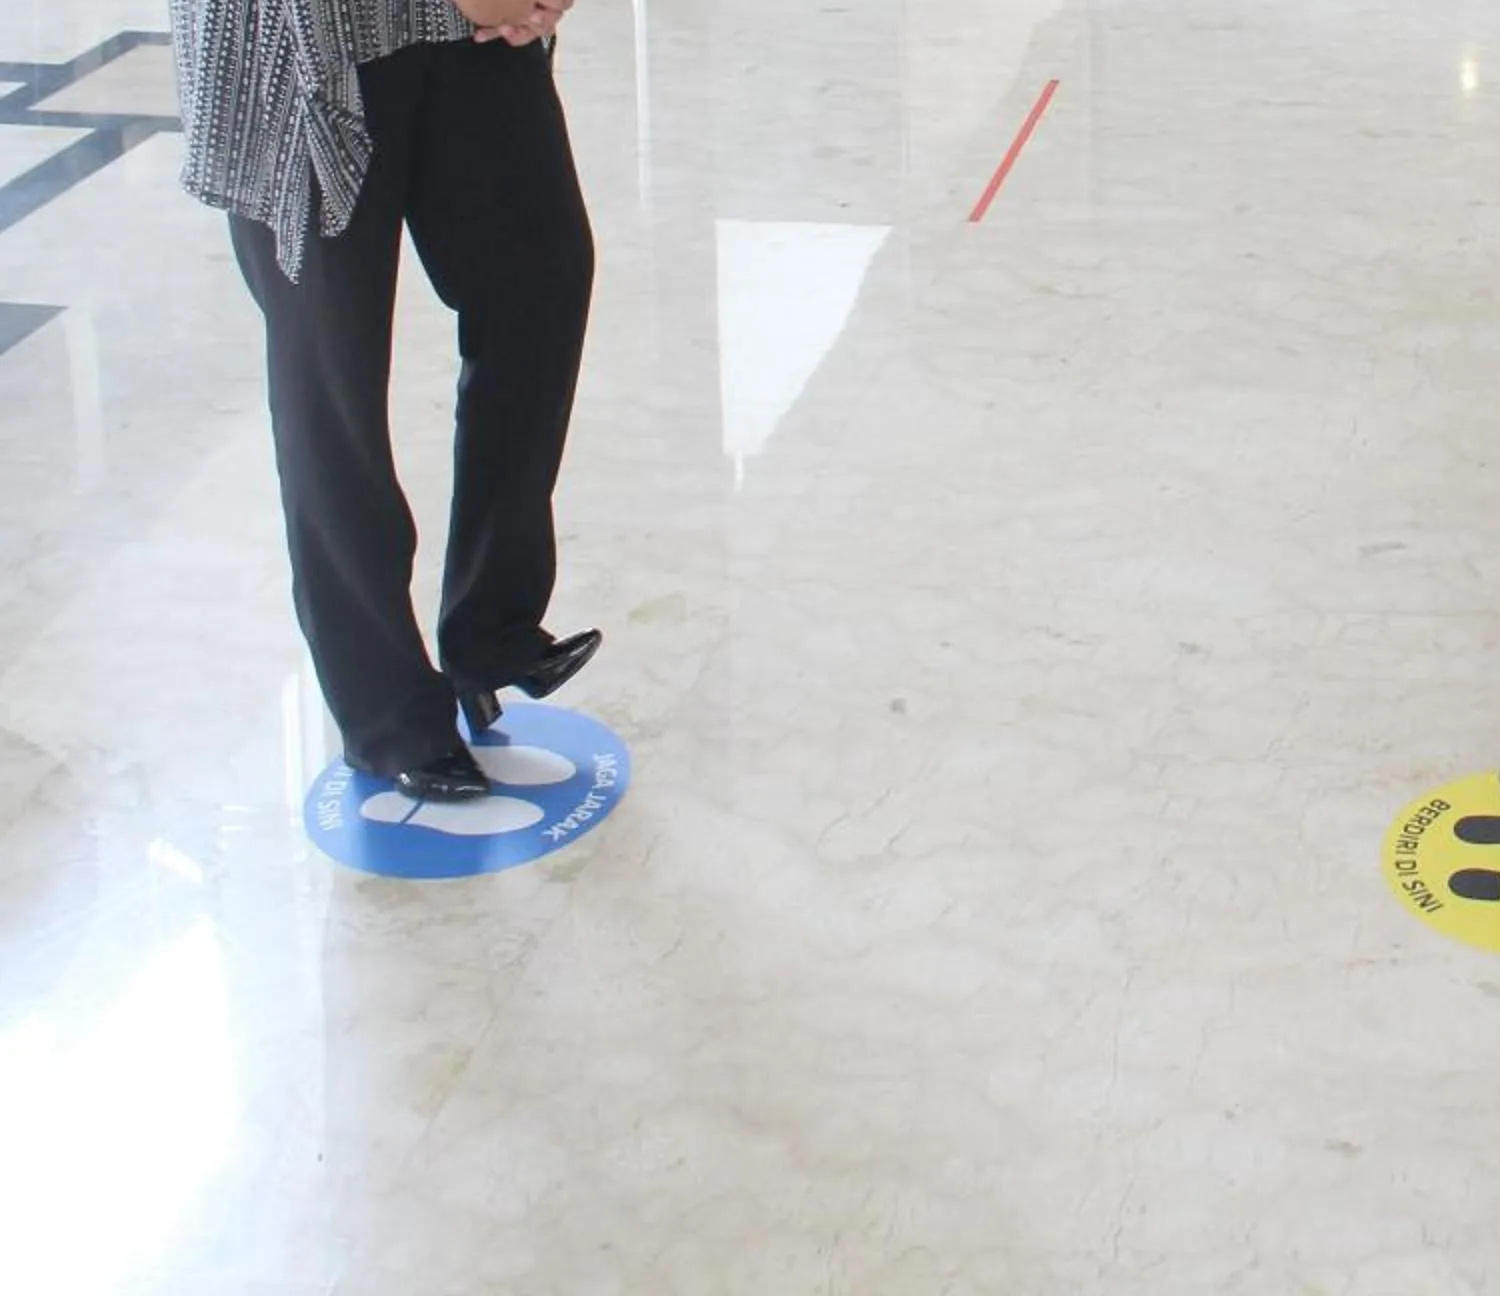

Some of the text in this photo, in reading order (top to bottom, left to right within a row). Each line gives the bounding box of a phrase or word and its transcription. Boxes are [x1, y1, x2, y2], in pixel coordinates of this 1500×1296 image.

[319, 800, 344, 831] SINI
[542, 753, 618, 842] JAGA JARAK
[1395, 798, 1451, 912] BERDIRI DI SINI
